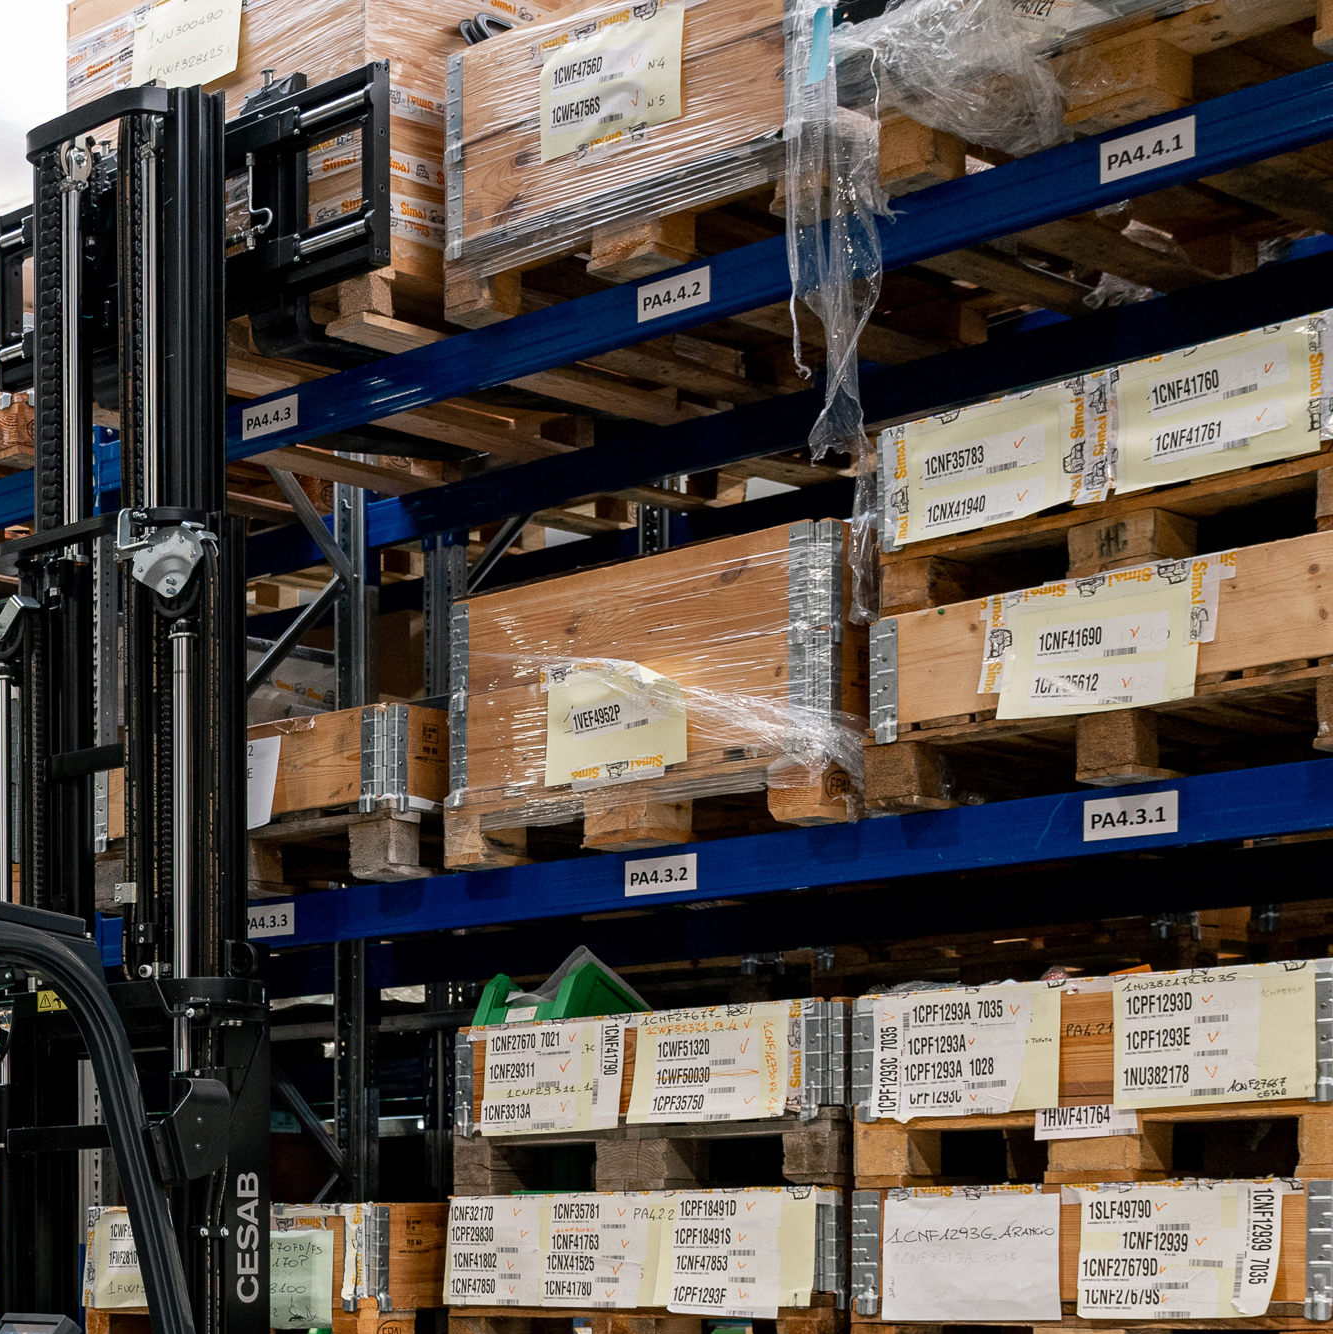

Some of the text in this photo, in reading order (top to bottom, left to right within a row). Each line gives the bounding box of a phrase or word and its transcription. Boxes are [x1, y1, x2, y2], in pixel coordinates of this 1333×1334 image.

[553, 56, 602, 86] 1CWF4756D
[552, 96, 601, 125] 1CWF4756S
[1107, 135, 1185, 172] PA4.4.1
[642, 280, 702, 314] PA4.4.2
[1152, 369, 1220, 405] 1CNF41760
[246, 407, 291, 431] PA4.4.3
[1155, 420, 1222, 452] 1CNF41761
[924, 445, 984, 476] 1CNF35783
[927, 495, 986, 523] 1CNX41940
[1039, 626, 1102, 652] 1CNF41690
[573, 704, 621, 731] 1VEF4952P
[1091, 806, 1166, 829] PA4.3.1
[630, 866, 688, 887] PA4.3.2
[913, 999, 1003, 1023] 1CPF1293A 7035
[1126, 992, 1193, 1015] 1CPF1293D
[491, 1031, 560, 1052] 1CNF27670 7021
[603, 1023, 619, 1076] 1CNF41790
[657, 1038, 710, 1059] 1CWF51320
[908, 1034, 966, 1055] 1CPF1293A
[1126, 1027, 1191, 1050] 1CPF1293E
[489, 1062, 535, 1080] 1CNF29311
[656, 1066, 710, 1085] 1CWF50030
[878, 1026, 898, 1114] 1CPF1293C 7035
[904, 1057, 994, 1082] 1CPF1293A 1028
[1123, 1064, 1190, 1087] 1NU382178
[484, 1103, 531, 1121] 1CNF3313A
[653, 1094, 704, 1111] 1CPF35750
[1042, 1104, 1111, 1127] 1HWF41764
[450, 1206, 494, 1221] 1CNF32170
[553, 1203, 600, 1219] 1CNF35781
[680, 1199, 737, 1218] 1CPF18491D
[1089, 1199, 1152, 1220] 1SLF49790
[236, 1171, 260, 1304] CESAB
[451, 1226, 494, 1242] 1CPF29830
[552, 1234, 600, 1250] 1CNF41763
[674, 1228, 731, 1245] 1CPF18491S
[1122, 1231, 1188, 1252] 1CNF12939
[1248, 1187, 1275, 1286] 1CNF12939 7035
[453, 1252, 497, 1269] 1CNF41802
[547, 1254, 595, 1272] 1CNX41525
[676, 1254, 728, 1272] 1CNF47853
[1083, 1258, 1158, 1277] 1CNF27679D
[451, 1278, 496, 1294] 1CNF47850
[673, 1285, 727, 1305] 1CPF1293F
